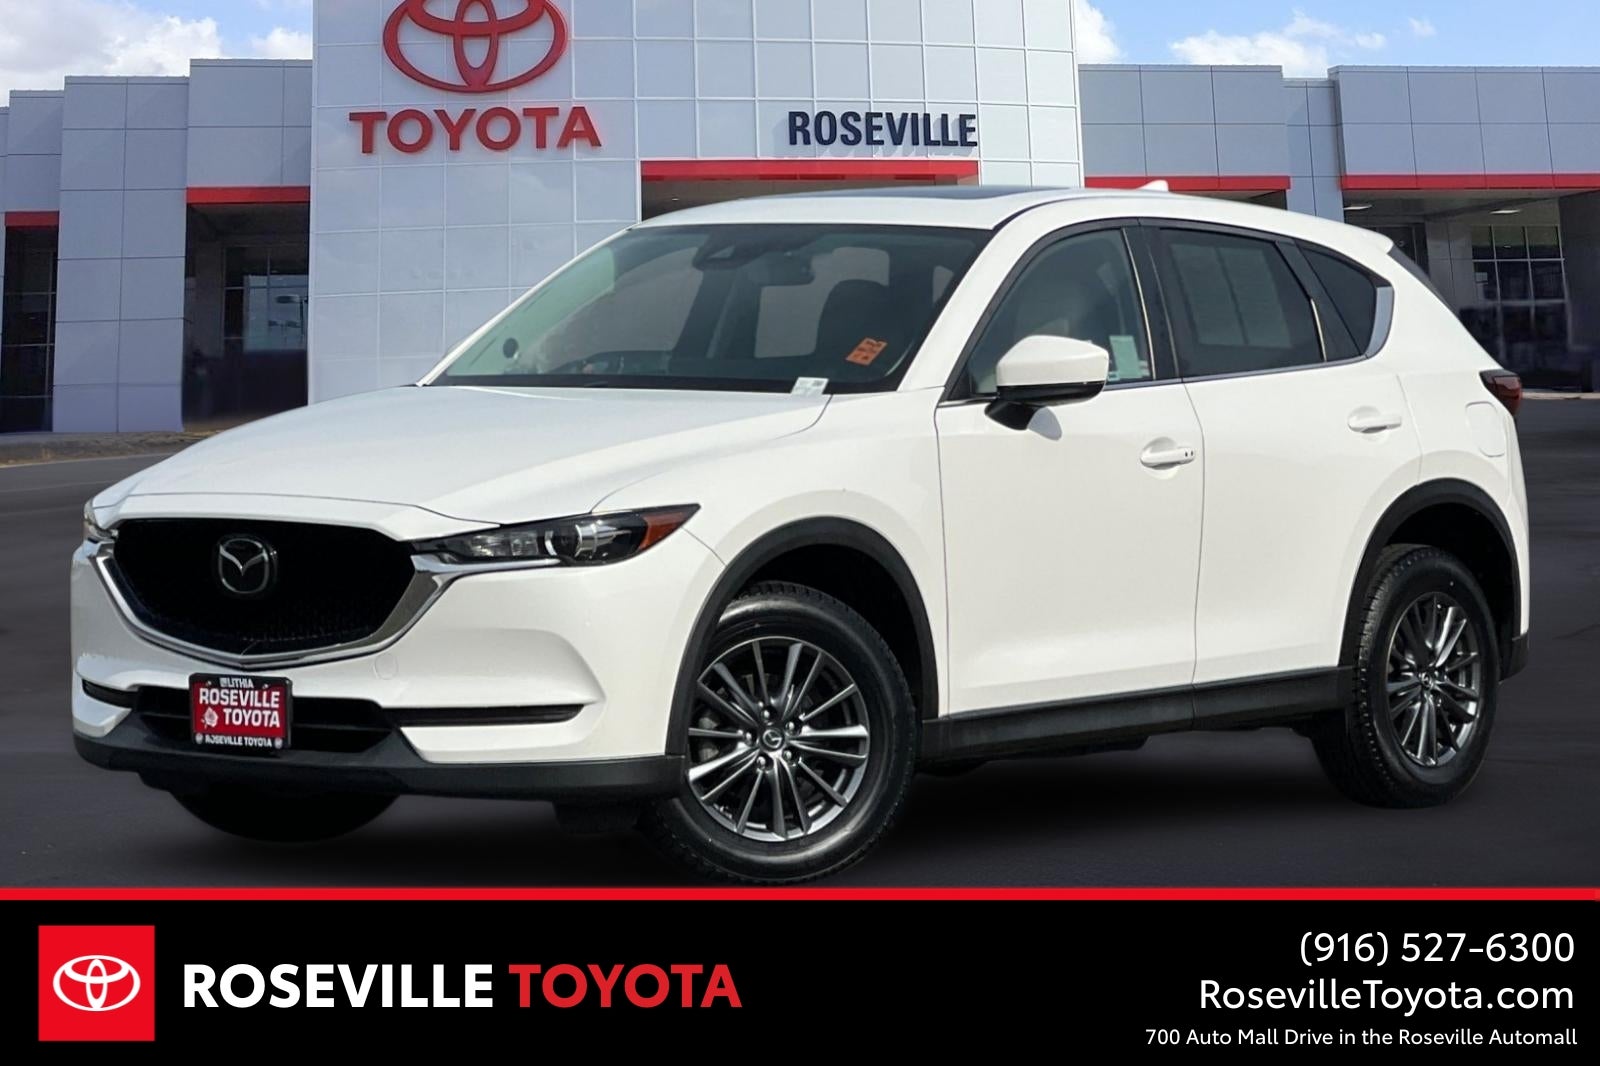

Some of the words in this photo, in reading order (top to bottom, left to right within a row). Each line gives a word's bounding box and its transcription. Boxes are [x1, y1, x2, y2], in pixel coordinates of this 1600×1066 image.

[349, 106, 601, 154] TOYOTA
[788, 110, 978, 147] ROSEVILLE
[227, 678, 254, 688] LITHIA
[199, 688, 280, 708] ROSEVILLE
[223, 708, 281, 728] TOYOTA
[205, 735, 242, 745] ROSEVILLE
[244, 737, 272, 747] TOYOTA
